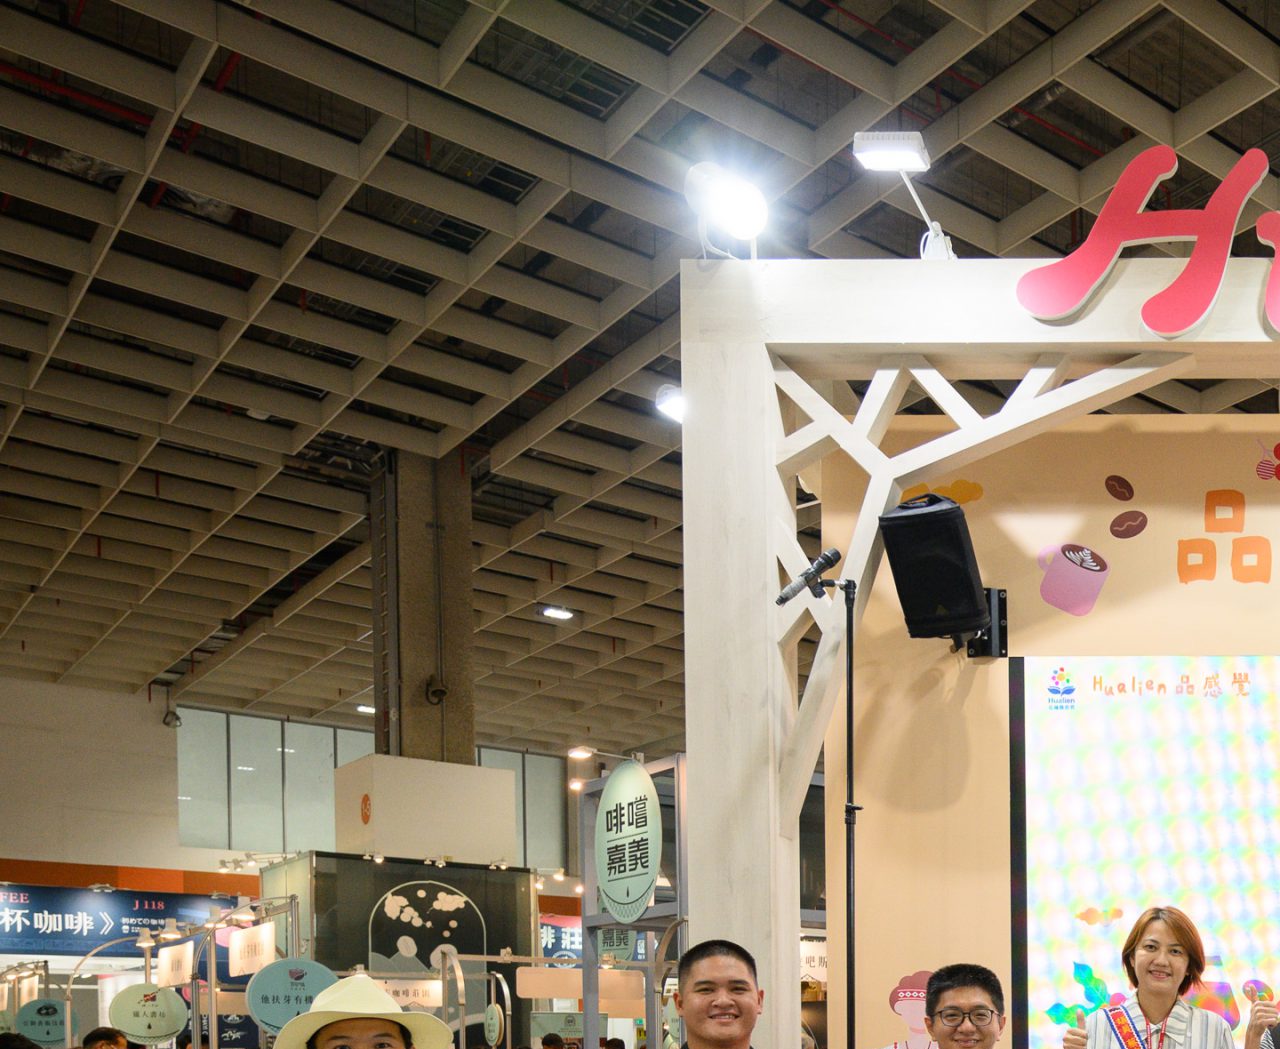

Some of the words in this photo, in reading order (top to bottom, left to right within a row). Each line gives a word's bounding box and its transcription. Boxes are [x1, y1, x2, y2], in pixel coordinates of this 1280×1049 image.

[1092, 675, 1167, 696] Hualien
[1175, 672, 1251, 698] 品感覺
[606, 837, 650, 877] 嘉義
[143, 900, 165, 910] 118
